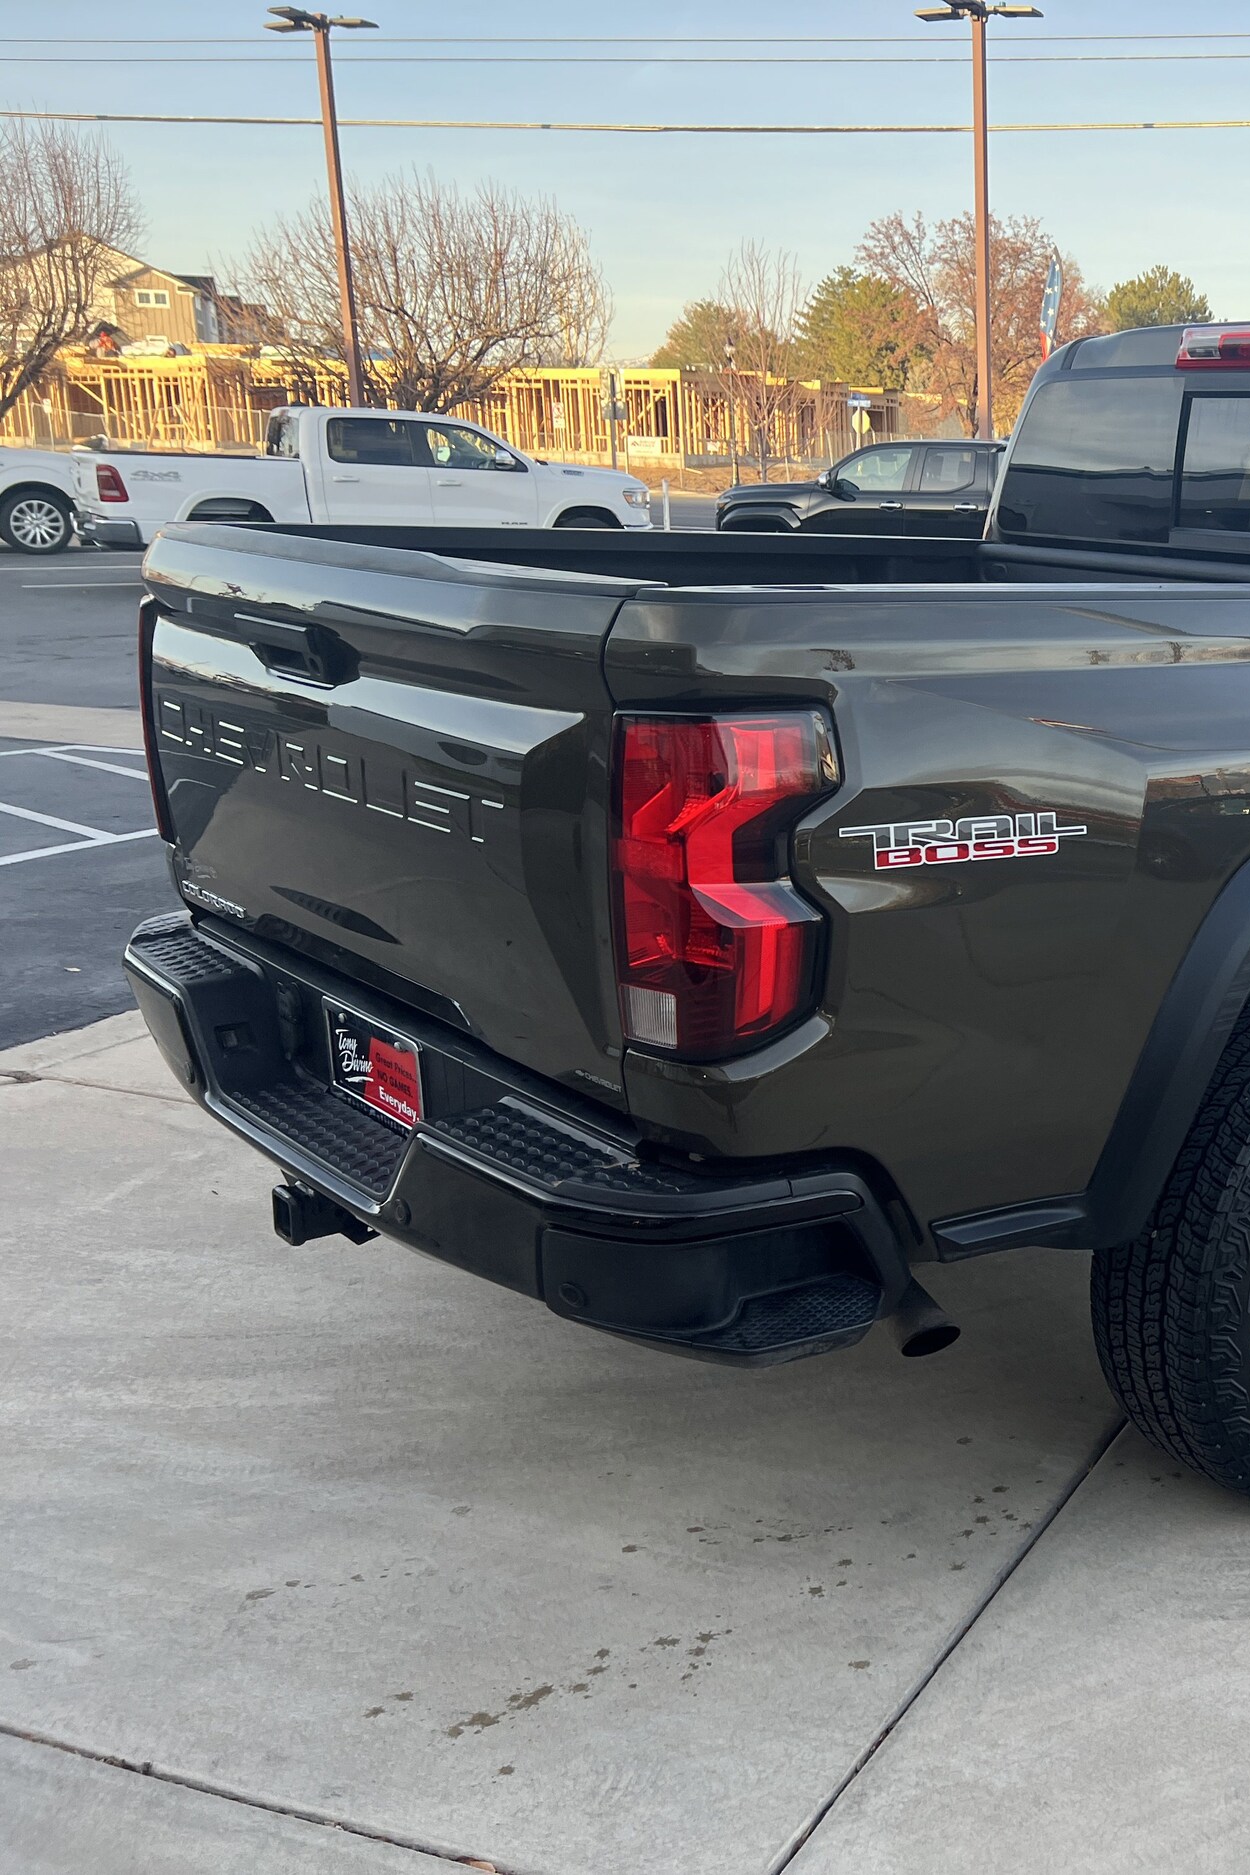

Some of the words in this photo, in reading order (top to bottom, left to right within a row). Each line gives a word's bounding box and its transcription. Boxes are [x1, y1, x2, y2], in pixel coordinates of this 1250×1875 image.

[158, 694, 505, 843] CHEVROLET
[839, 812, 1087, 848] TRAIL
[874, 836, 1059, 870] BOSS
[181, 880, 247, 919] COLORADO
[335, 1029, 358, 1051] Tony
[377, 1069, 388, 1083] NO
[378, 1085, 420, 1122] Everyday.
